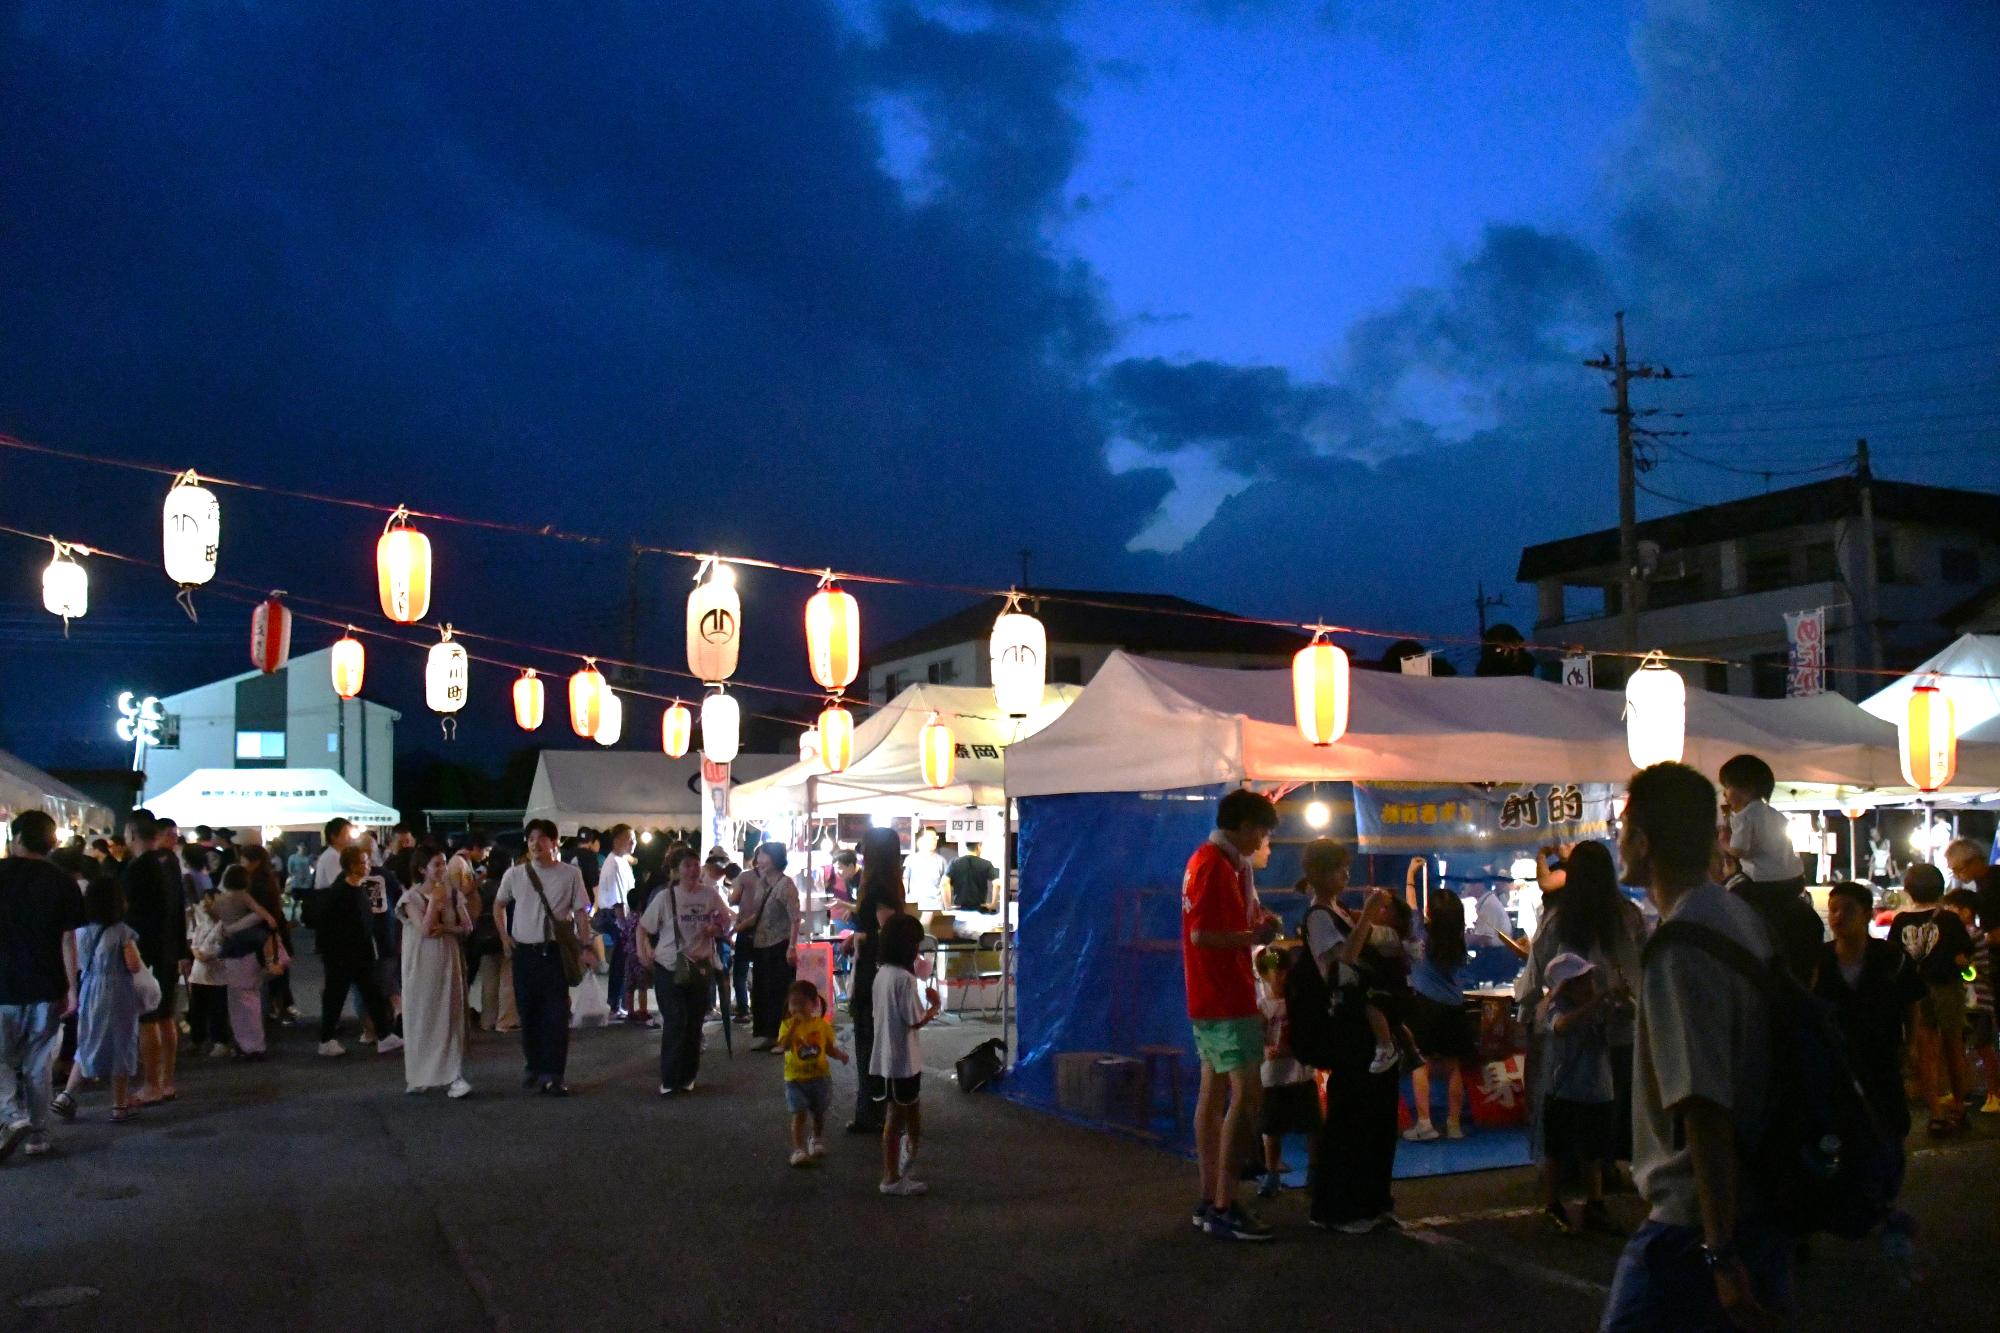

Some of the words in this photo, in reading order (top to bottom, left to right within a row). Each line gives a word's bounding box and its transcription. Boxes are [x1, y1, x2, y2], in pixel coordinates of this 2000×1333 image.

[448, 650, 463, 702] 天川町
[952, 820, 984, 831] 四丁目
[1499, 783, 1584, 831] 射的
